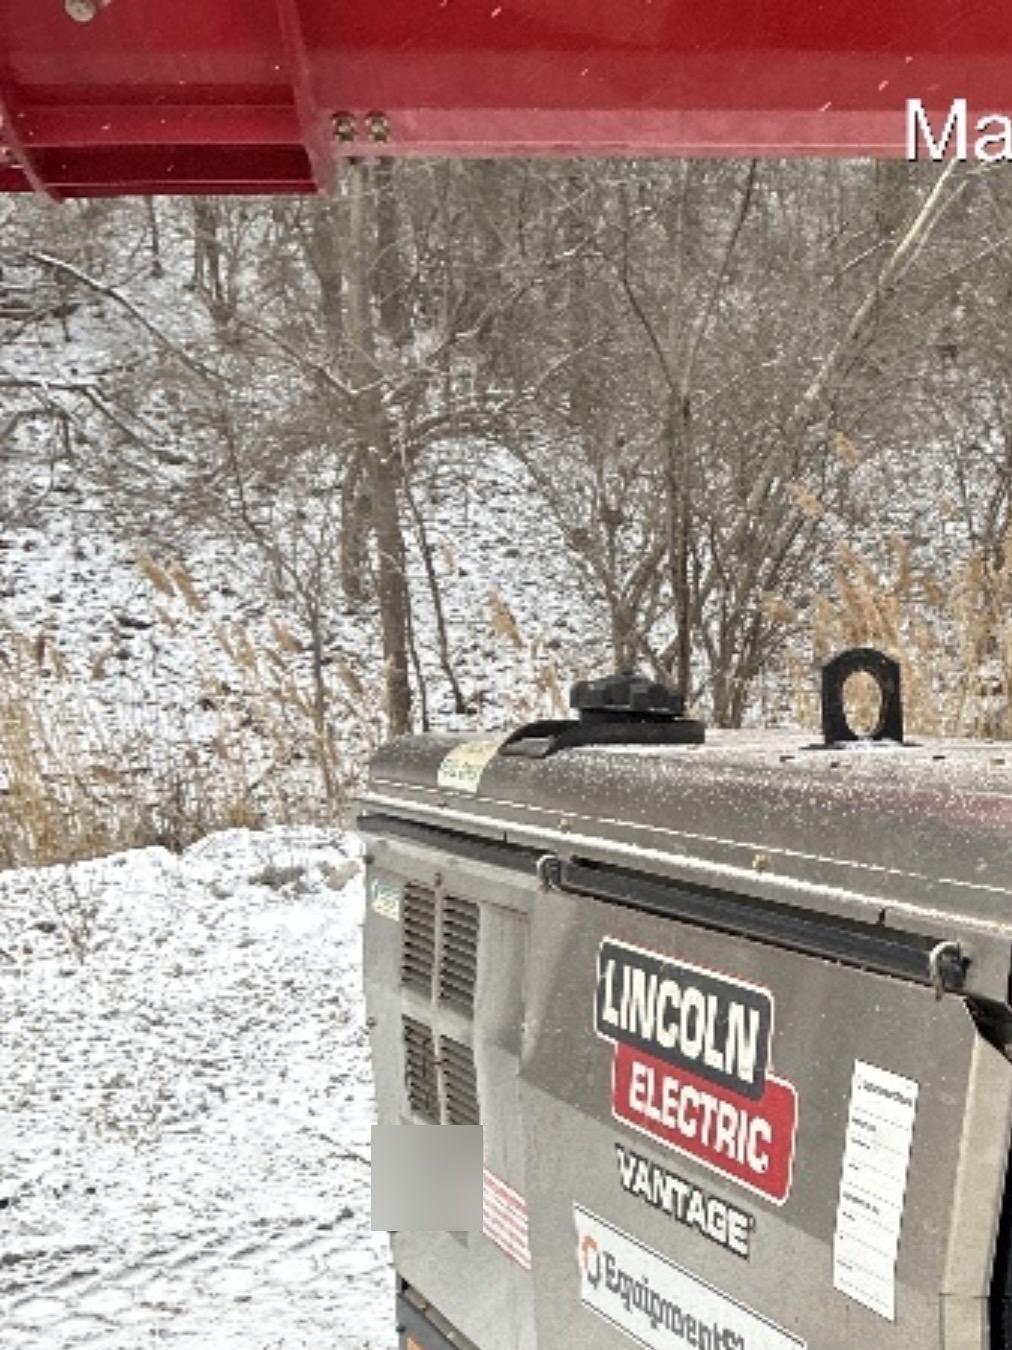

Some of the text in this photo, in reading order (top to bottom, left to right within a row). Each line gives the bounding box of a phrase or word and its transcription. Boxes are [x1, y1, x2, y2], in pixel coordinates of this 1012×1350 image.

[602, 957, 760, 1084] LINCOLN
[628, 1060, 774, 1175] ELECTRIC
[615, 1144, 755, 1260] VANTAGE
